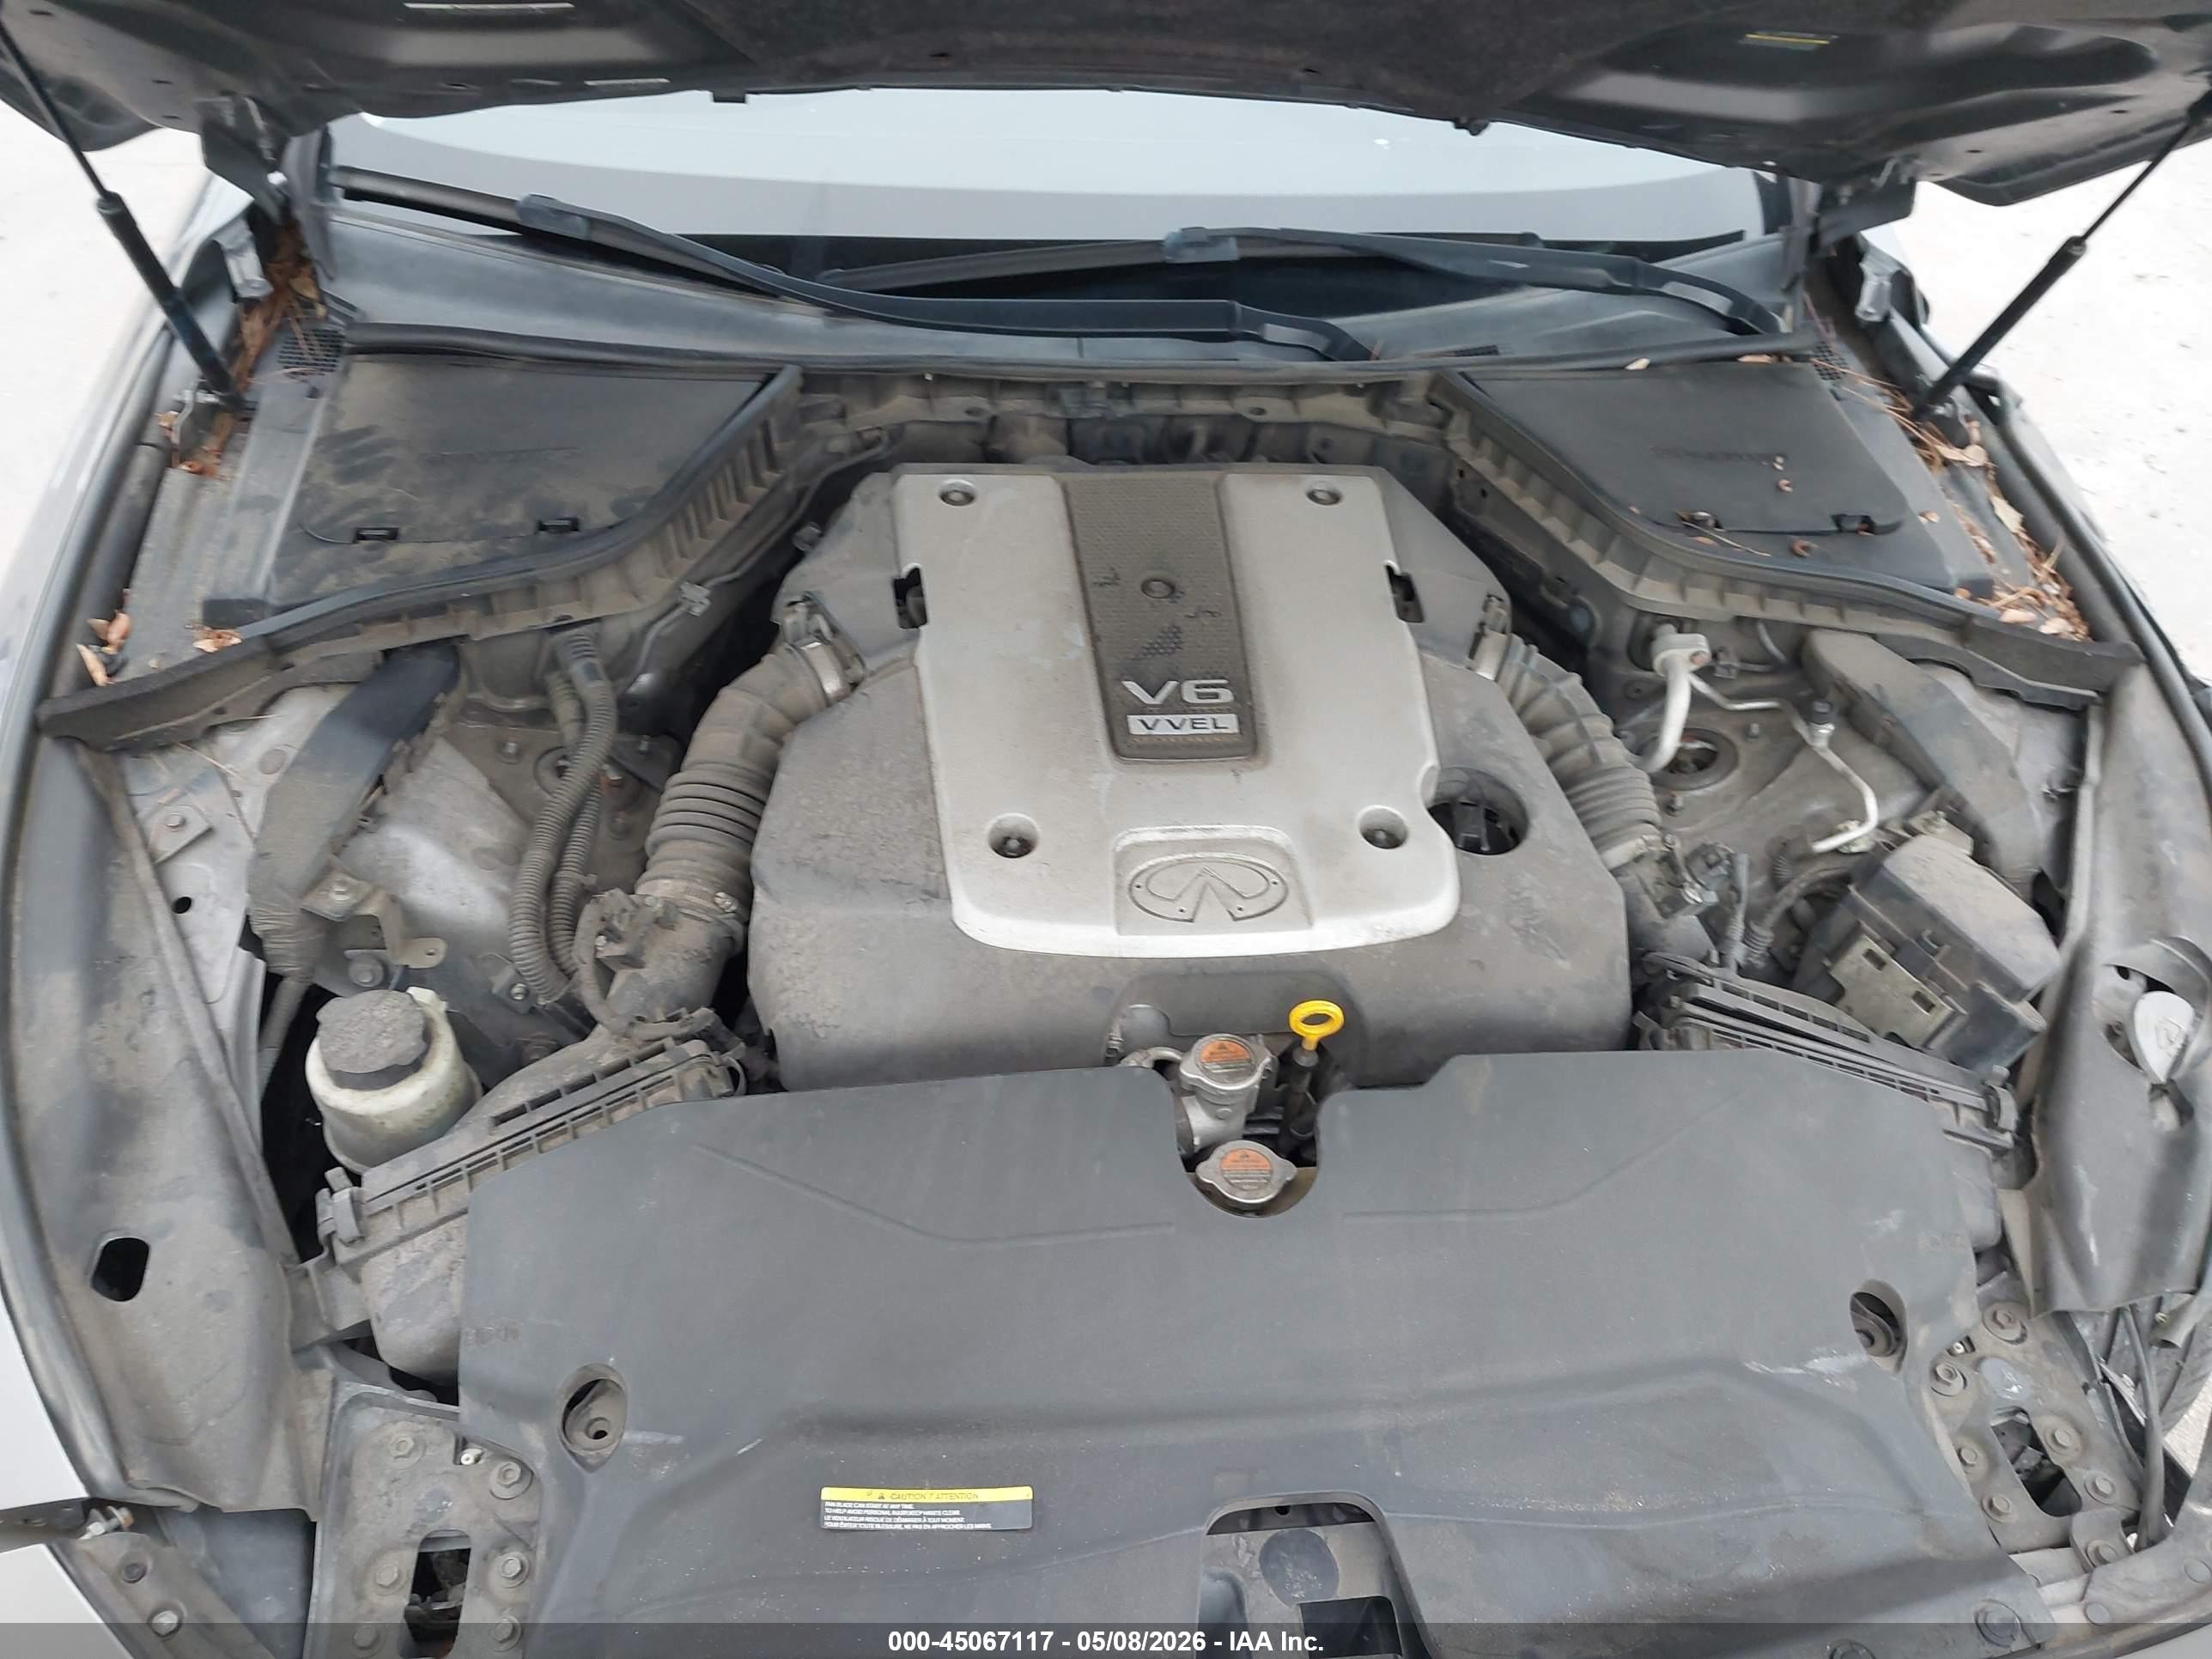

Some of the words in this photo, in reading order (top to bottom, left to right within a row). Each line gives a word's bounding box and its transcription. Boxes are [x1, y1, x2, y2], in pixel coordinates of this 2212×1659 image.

[1121, 678, 1235, 705] V6
[1137, 718, 1230, 731] VVEL
[890, 1492, 926, 1501] CAUTION
